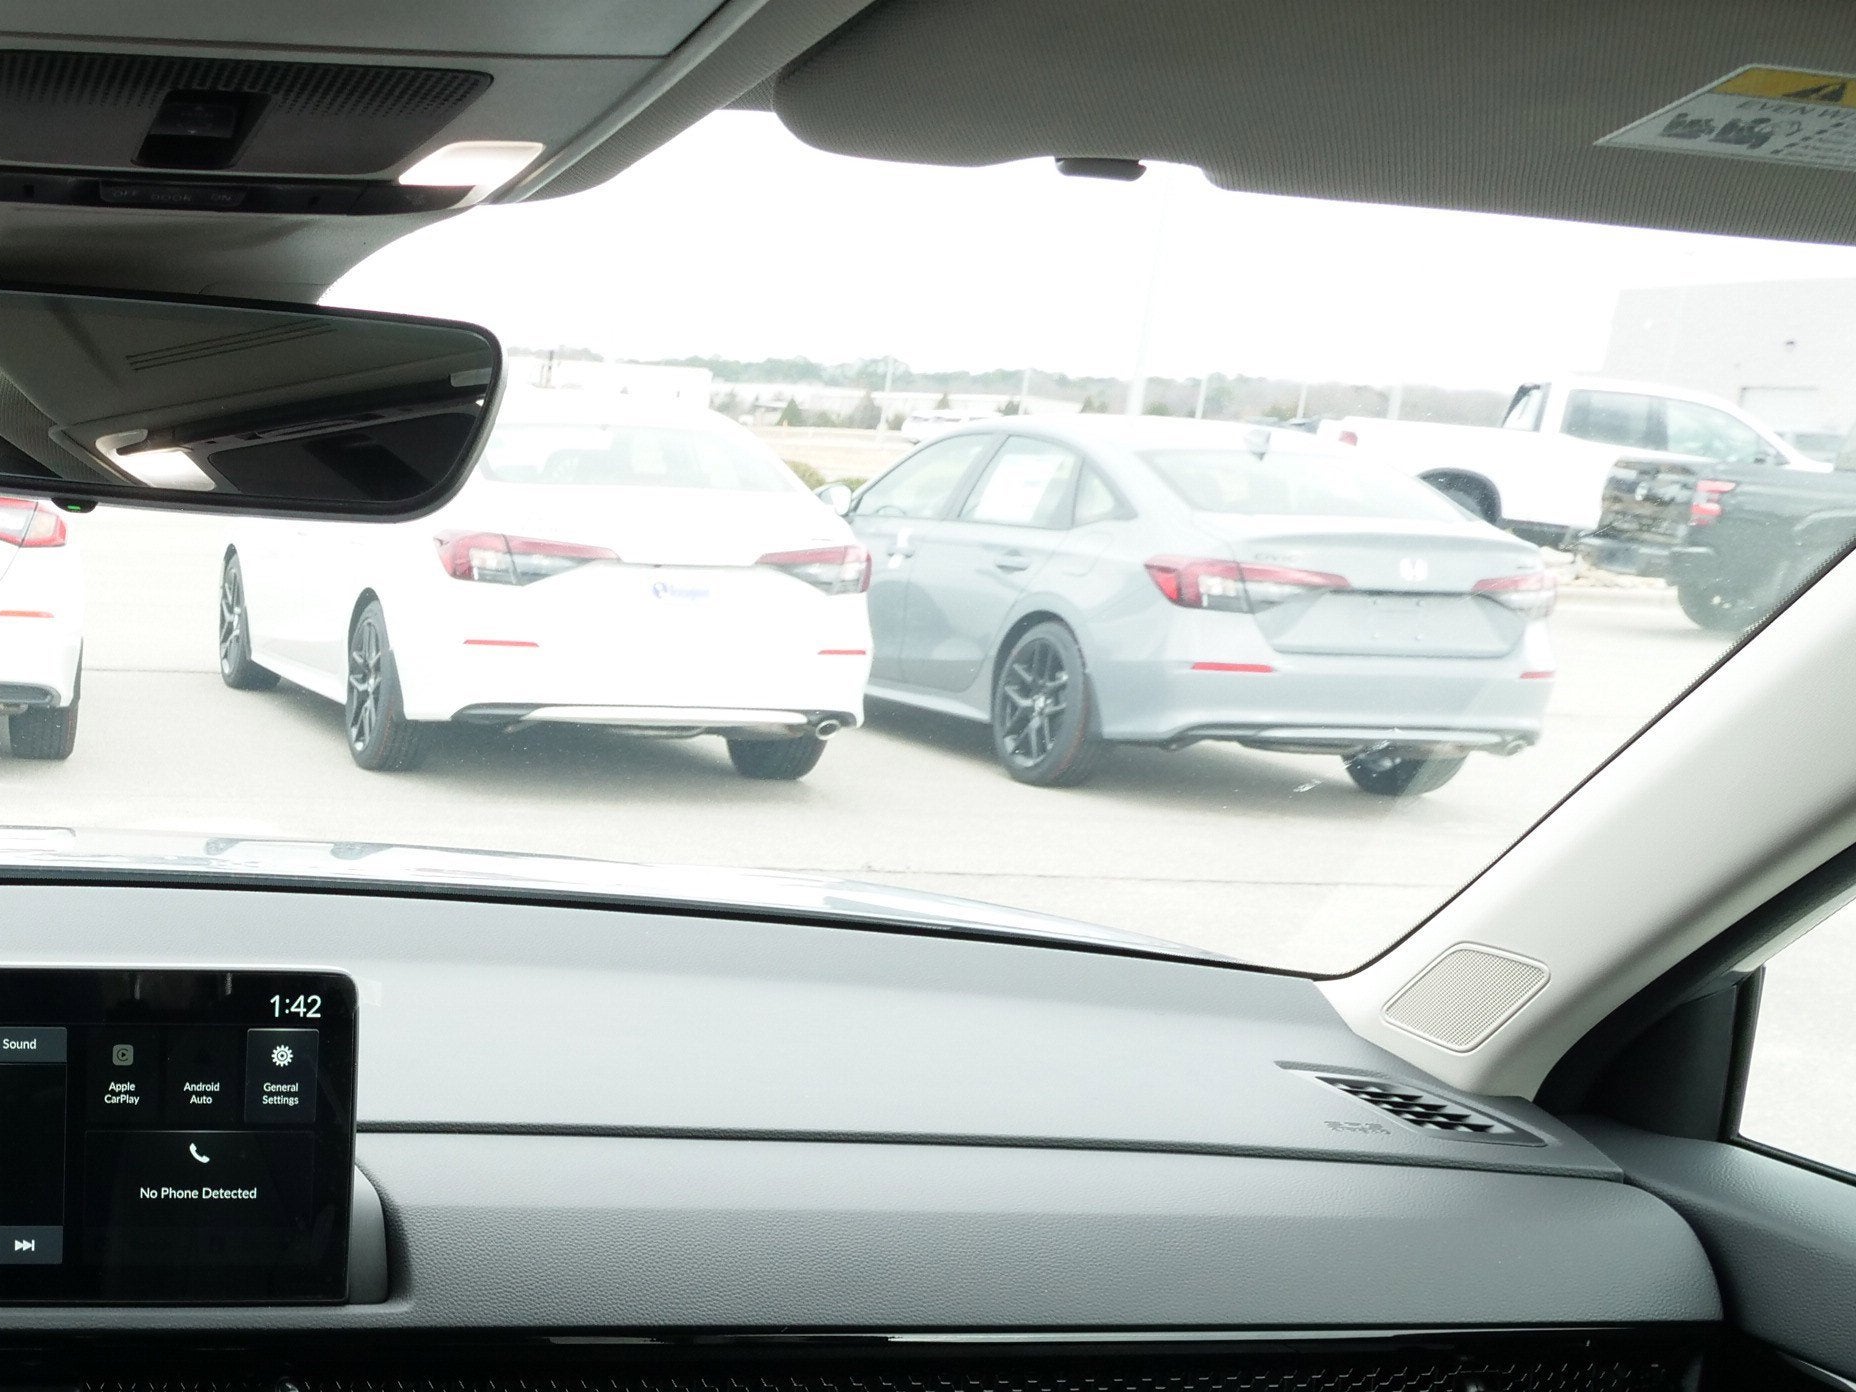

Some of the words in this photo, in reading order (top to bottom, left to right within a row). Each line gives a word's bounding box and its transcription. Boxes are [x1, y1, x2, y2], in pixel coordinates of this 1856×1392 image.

[270, 994, 322, 1018] 1:42
[2, 1038, 37, 1050] Sound
[108, 1081, 136, 1092] Apple
[183, 1082, 220, 1092] Android
[263, 1082, 299, 1092] General
[104, 1094, 140, 1105] CarPlay
[190, 1095, 213, 1105] Auto
[262, 1095, 299, 1107] Settings
[140, 1187, 158, 1199] No
[160, 1187, 199, 1199] Phone
[202, 1187, 257, 1200] Detected
